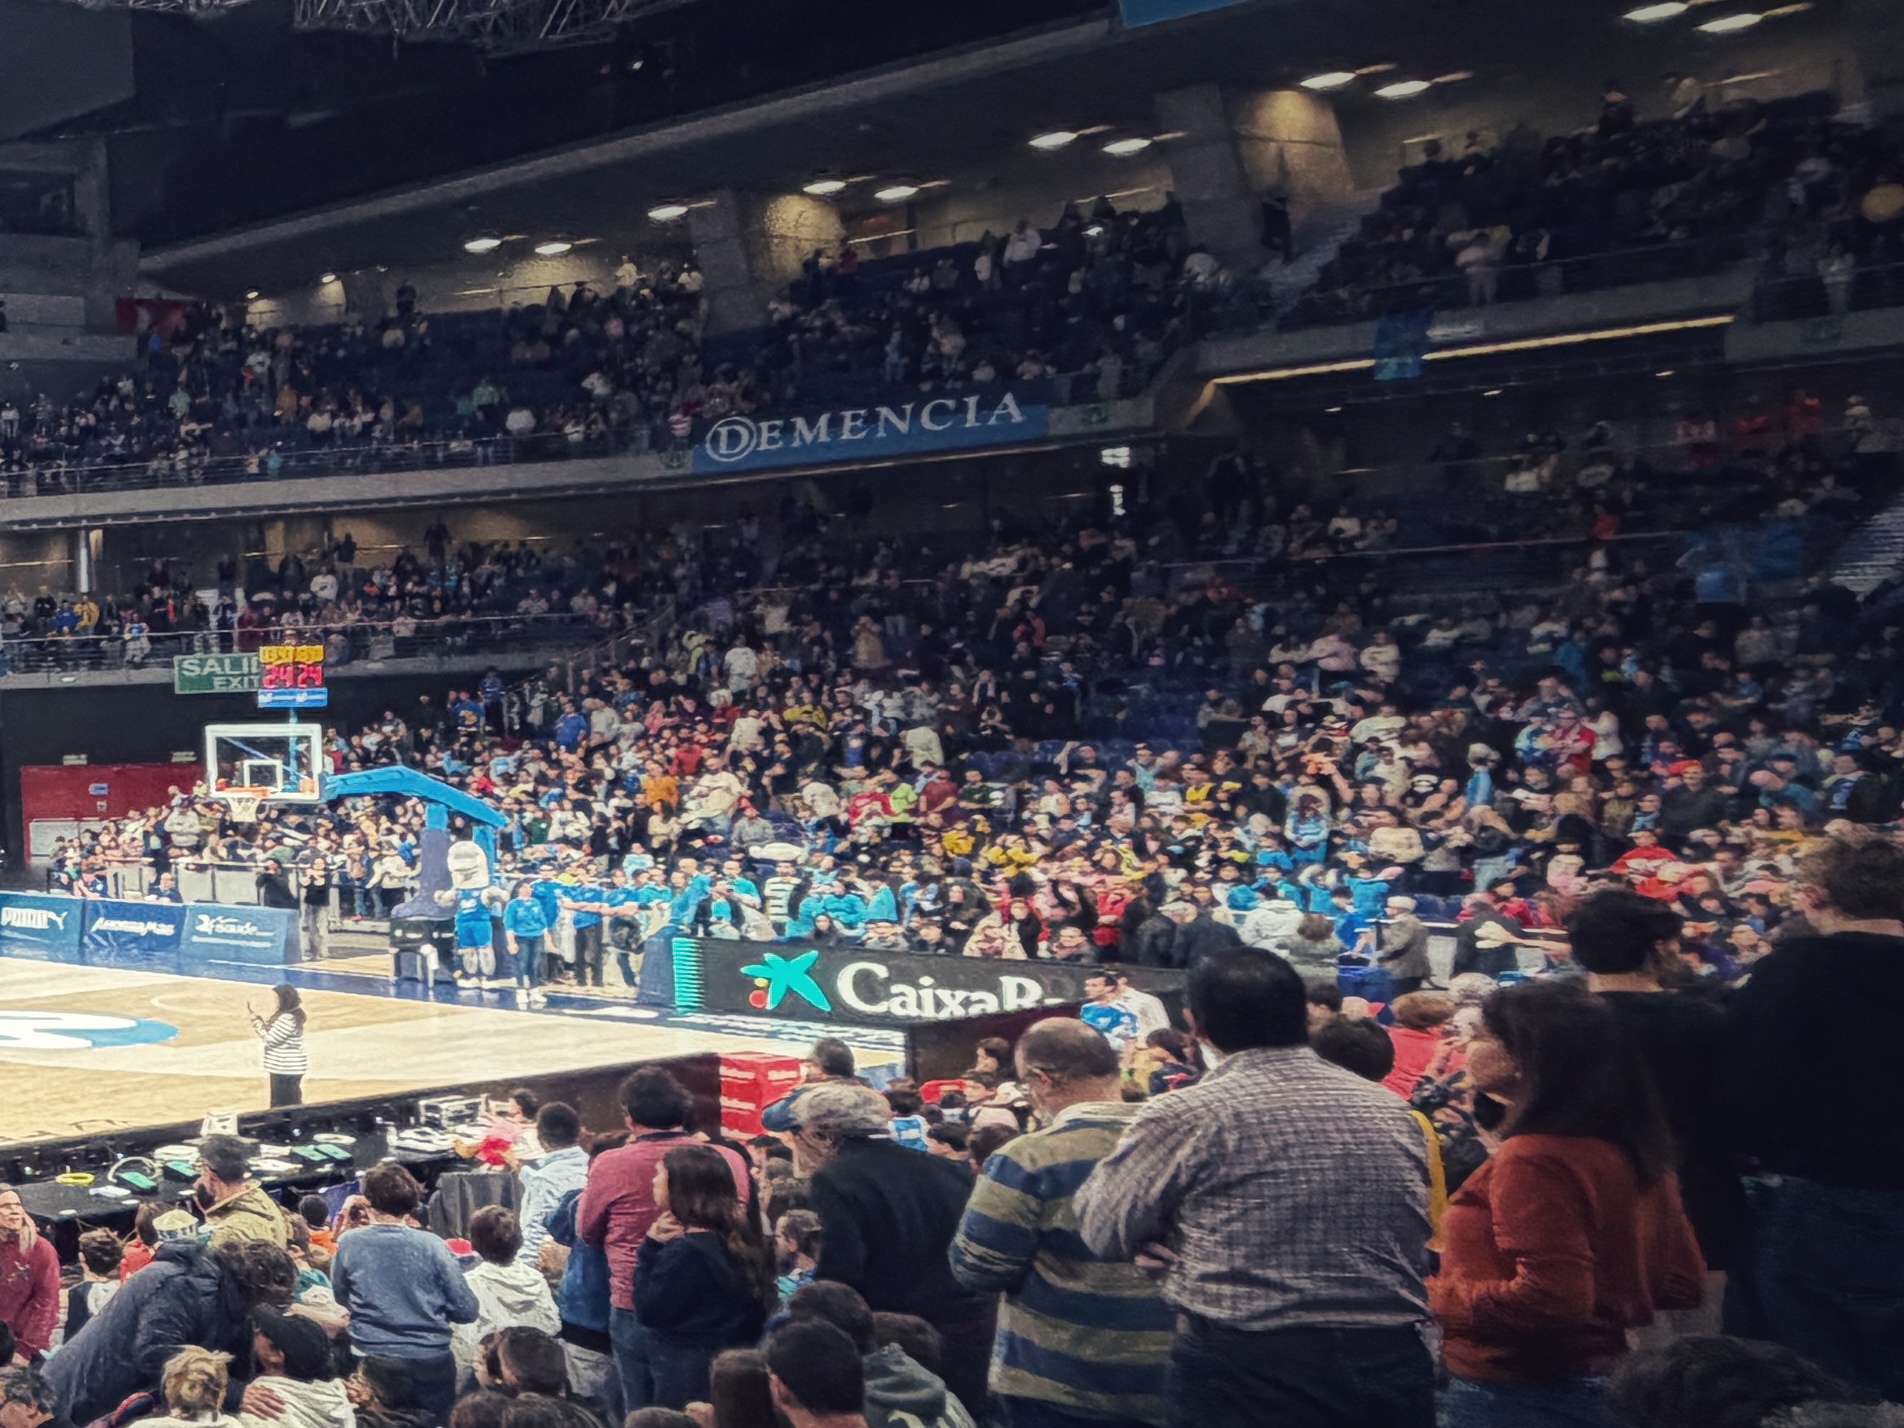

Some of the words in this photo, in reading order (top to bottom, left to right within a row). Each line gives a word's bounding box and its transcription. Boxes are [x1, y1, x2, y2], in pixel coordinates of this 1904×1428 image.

[708, 392, 1023, 461] DEMENCIA
[181, 658, 259, 677] SALI
[212, 677, 259, 690] EXIT
